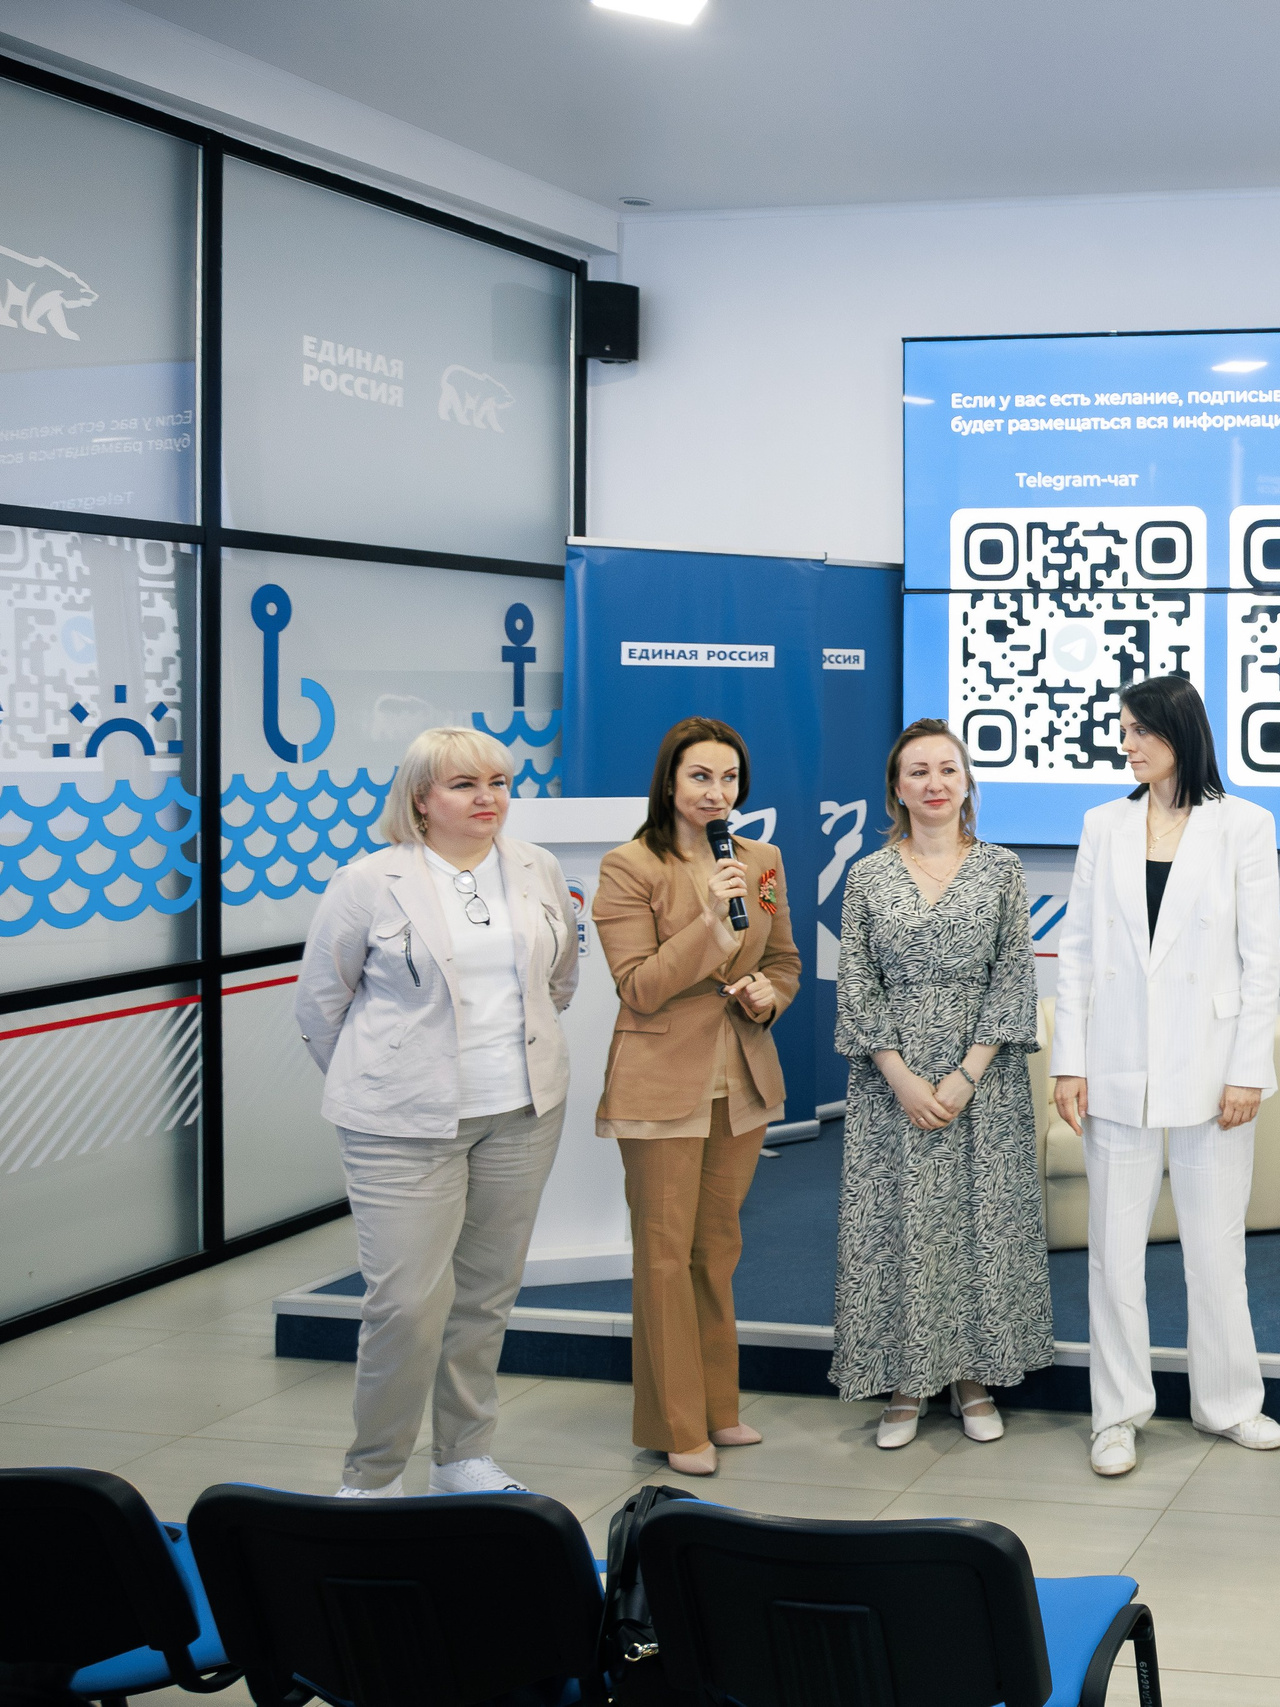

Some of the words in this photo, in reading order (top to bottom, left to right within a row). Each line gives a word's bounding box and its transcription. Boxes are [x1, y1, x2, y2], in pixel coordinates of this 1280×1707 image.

[303, 334, 404, 380] ЕДИНАЯ
[303, 363, 404, 408] РОССИЯ
[951, 393, 996, 409] Если
[999, 395, 1010, 411] у
[1015, 394, 1046, 408] вас
[1050, 393, 1091, 407] есть
[1094, 390, 1183, 408] желание,
[951, 415, 1003, 435] будет
[1008, 415, 1131, 434] размещаться
[1136, 415, 1168, 429] вся
[1015, 472, 1139, 491] Telegram-чат
[628, 648, 698, 661] ЕДИНАЯ
[707, 649, 769, 662] РОССИЯ
